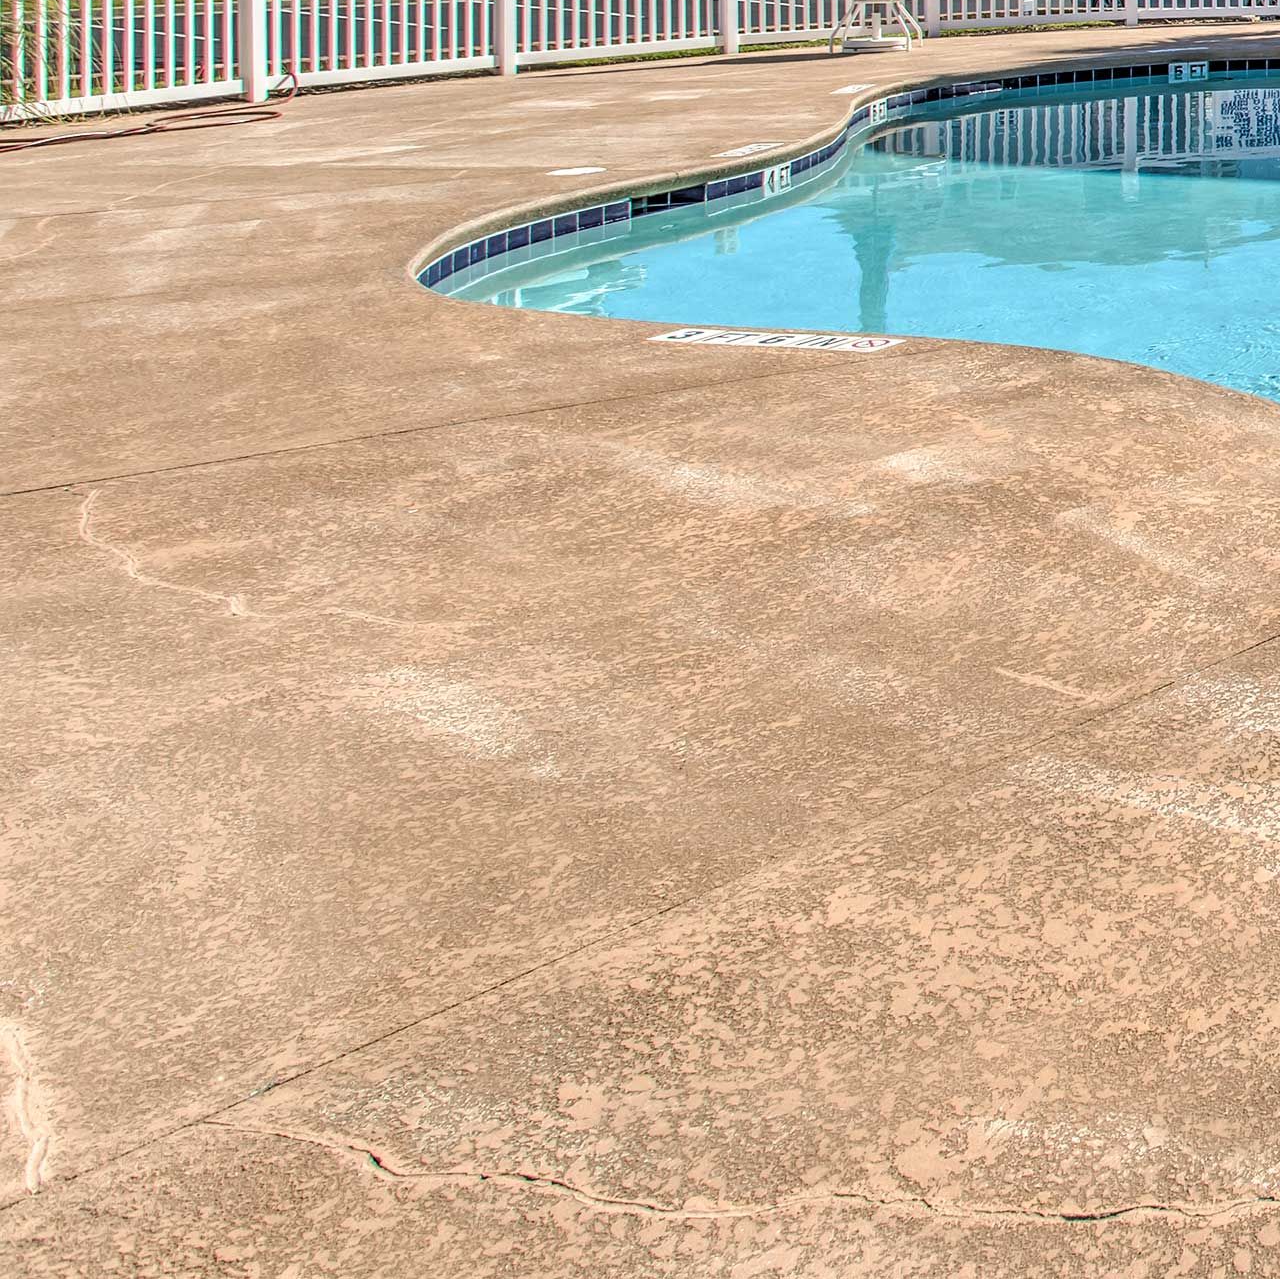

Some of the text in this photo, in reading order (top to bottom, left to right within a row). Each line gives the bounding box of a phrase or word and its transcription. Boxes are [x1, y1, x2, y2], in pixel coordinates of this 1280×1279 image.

[667, 330, 849, 347] 3 FT 6 IN
